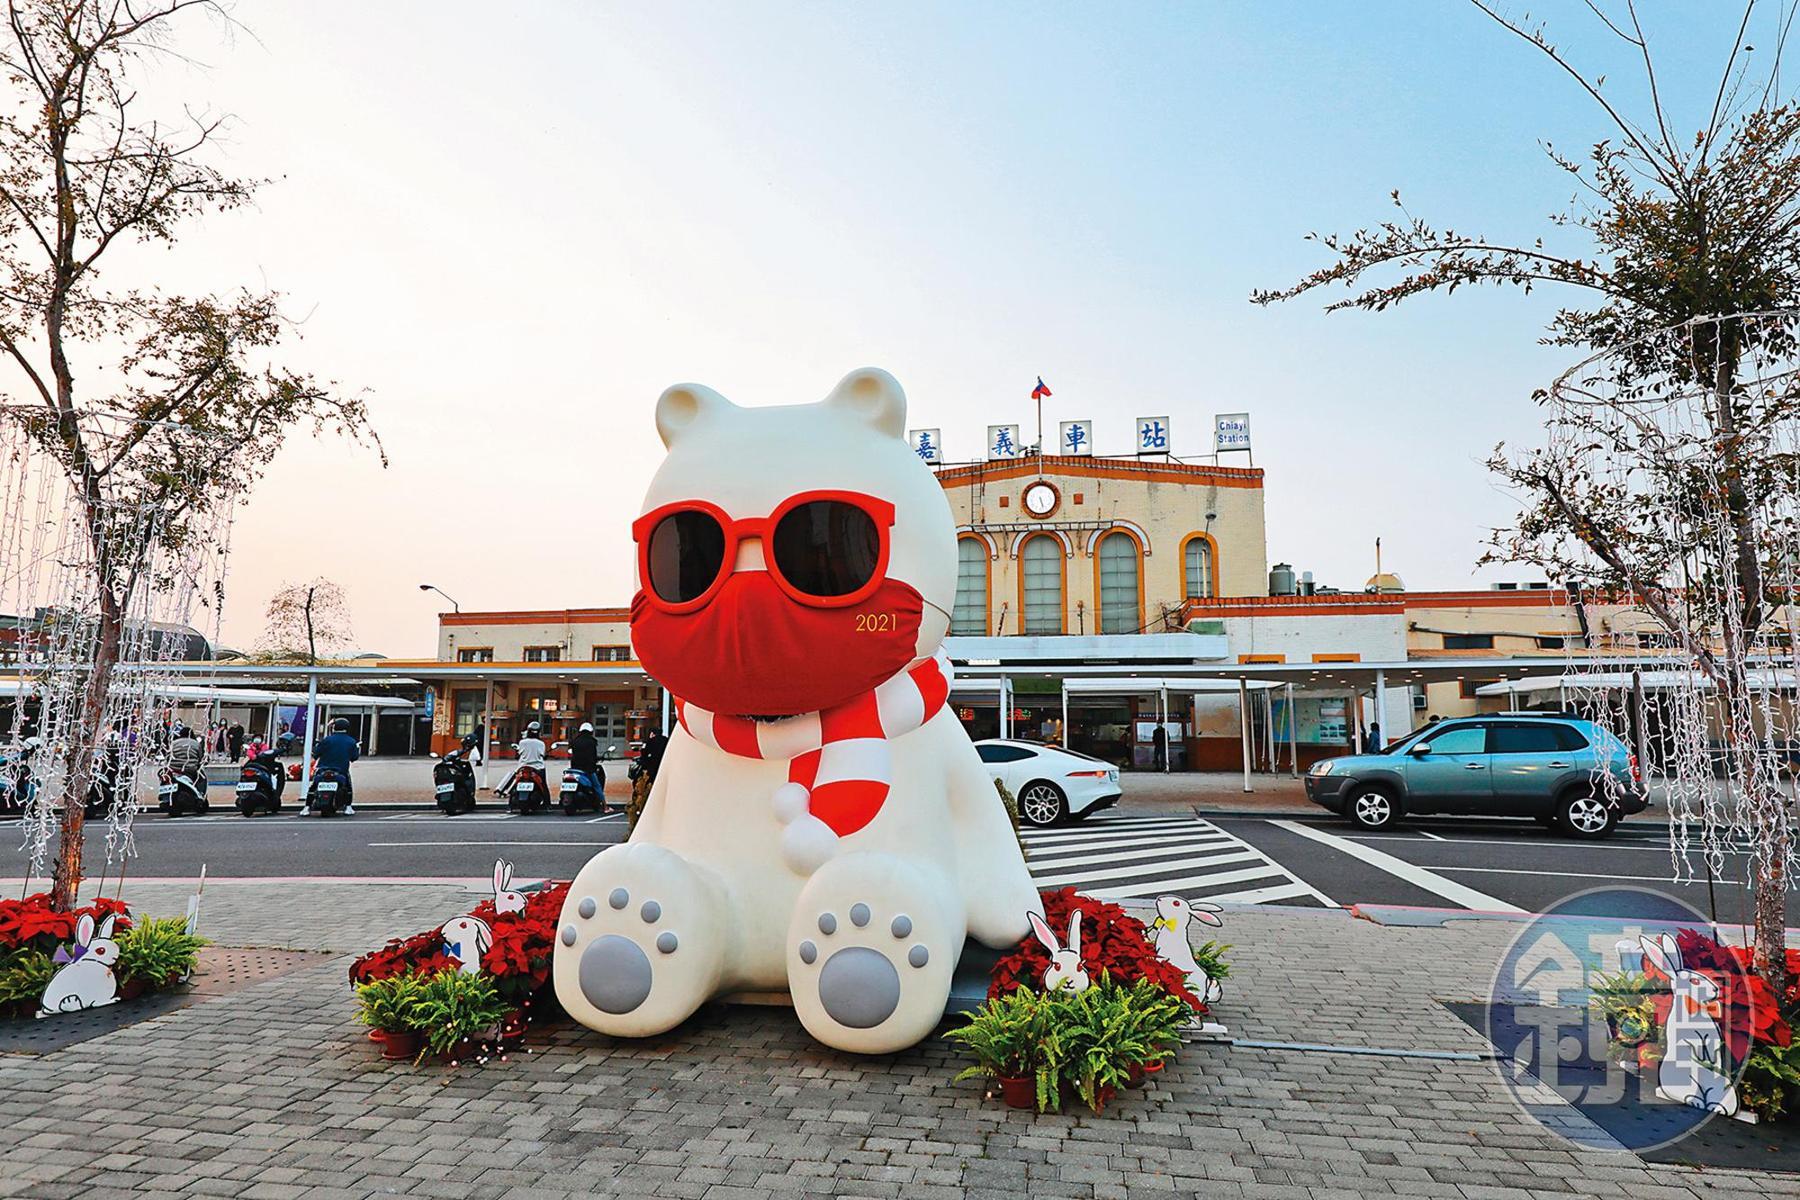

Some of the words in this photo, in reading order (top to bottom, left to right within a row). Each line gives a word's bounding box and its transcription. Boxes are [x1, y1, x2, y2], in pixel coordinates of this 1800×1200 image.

[1219, 420, 1247, 431] Chiayi
[915, 421, 1166, 460] 嘉義車站
[1218, 433, 1249, 443] Station
[855, 614, 896, 631] 2021
